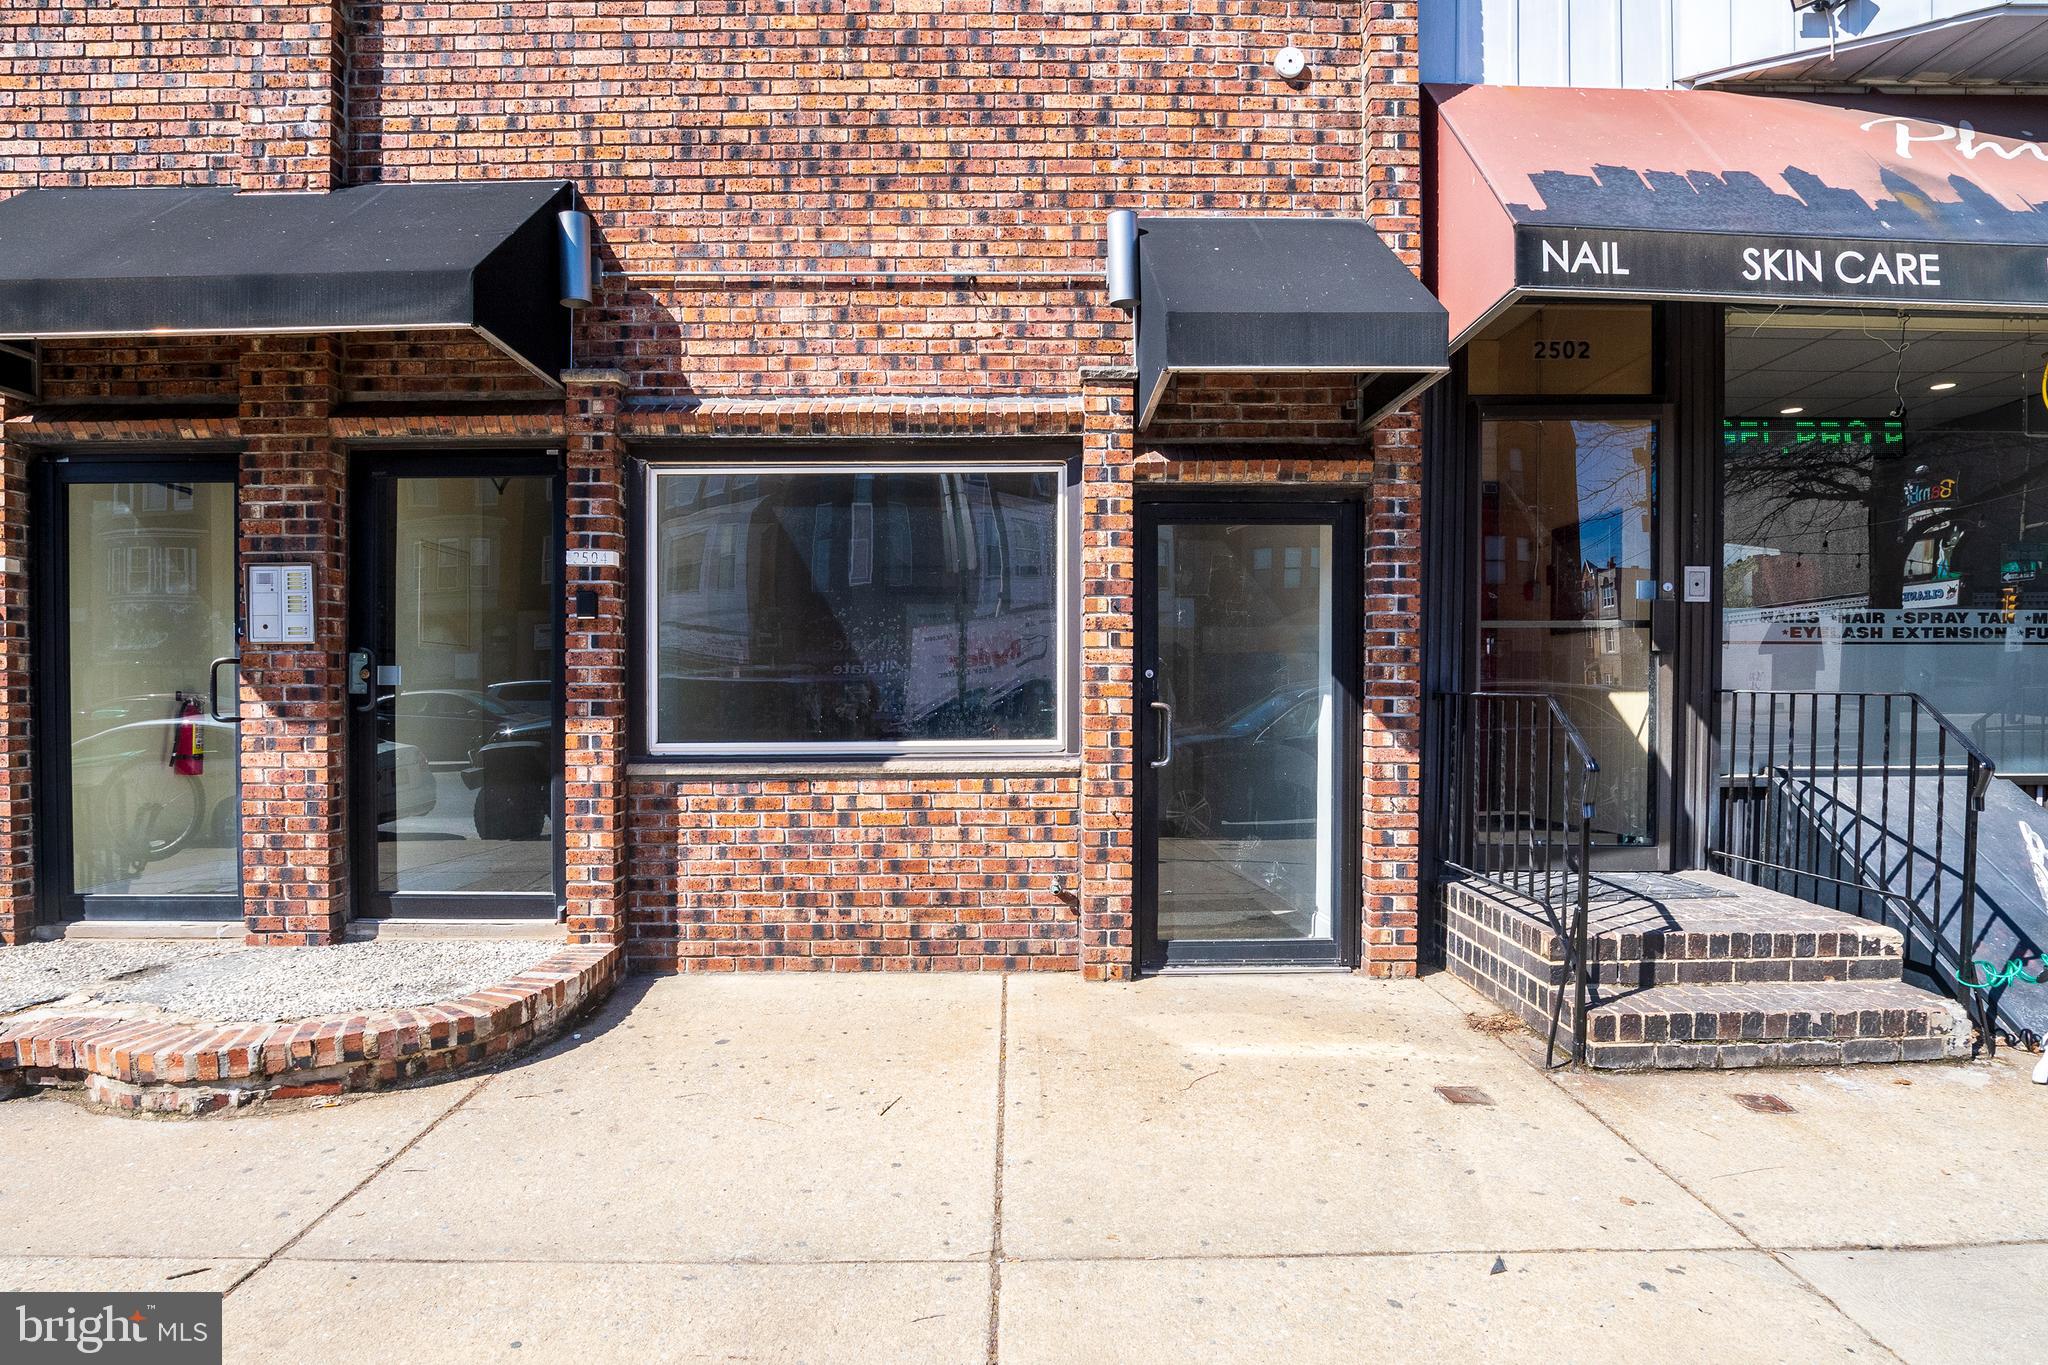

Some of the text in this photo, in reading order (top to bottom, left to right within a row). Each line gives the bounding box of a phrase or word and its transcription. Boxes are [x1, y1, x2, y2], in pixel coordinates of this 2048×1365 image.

[1542, 240, 1630, 276] NAIL
[1742, 247, 1941, 287] SKIN CARE
[1534, 340, 1590, 360] 2502
[1904, 612, 1969, 624] SPRAY
[1892, 626, 2006, 639] EXTENSION
